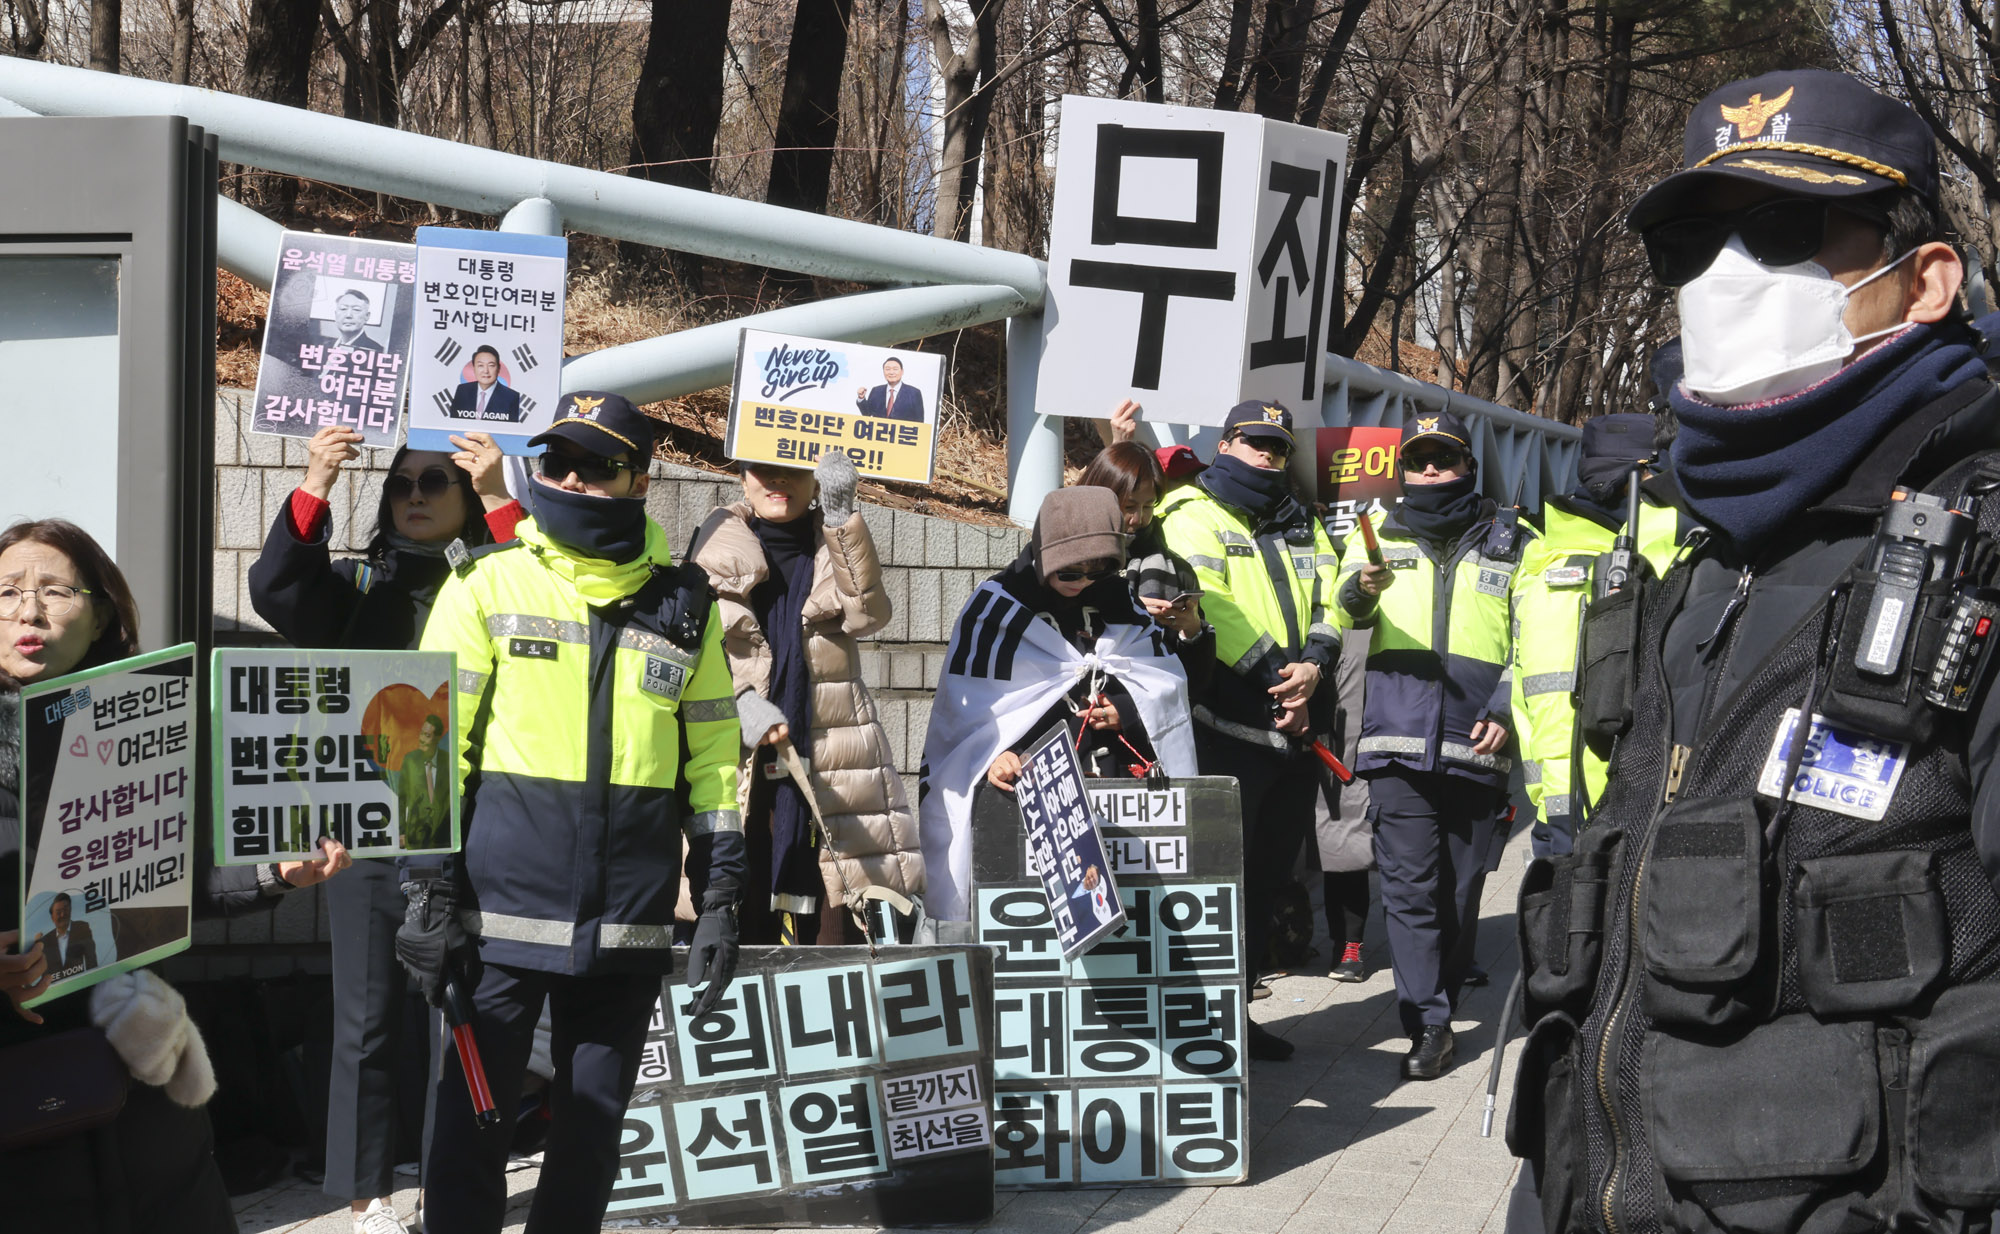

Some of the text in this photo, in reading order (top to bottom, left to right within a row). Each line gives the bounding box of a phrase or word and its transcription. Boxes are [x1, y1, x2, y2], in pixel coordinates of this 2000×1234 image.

[282, 248, 416, 284] 윤석열 대통령
[458, 257, 515, 282] 대통령
[1069, 124, 1237, 391] 무
[1250, 160, 1338, 401] 죄
[424, 280, 557, 312] 변호인단여러분
[432, 308, 536, 333] 감사합니다!
[299, 343, 402, 380] 변호인단
[764, 343, 831, 372] Never
[812, 360, 840, 389] up
[320, 373, 398, 407] 여러분
[264, 395, 395, 434] 감사합니다
[457, 410, 510, 420] YOON AGAIN
[754, 406, 919, 446] 변호인단 여러분
[1478, 583, 1505, 596] POLICE
[230, 666, 351, 714] 대통령
[646, 678, 679, 697] POLICE
[649, 659, 681, 685] 경찰
[44, 676, 189, 732] 대통령 변호인단
[117, 720, 189, 767] 여러분
[231, 734, 391, 785] 변호인단
[58, 766, 188, 834] 감사합니다
[1050, 739, 1088, 840] 대통령
[232, 802, 393, 857] 힘내세요
[1033, 753, 1083, 885] 변호인단
[57, 811, 188, 880] 응원합니다
[1015, 770, 1078, 944] 감사합니다
[83, 852, 185, 915] 힘내세요!
[62, 963, 84, 977] YOON
[680, 958, 972, 1078] 힘내라
[995, 986, 1237, 1075] 대통령
[885, 1067, 980, 1114] 끝까지
[613, 1082, 880, 1199] 윤석열
[892, 1113, 985, 1153] 최선을
[995, 1086, 1239, 1179] 화이팅
